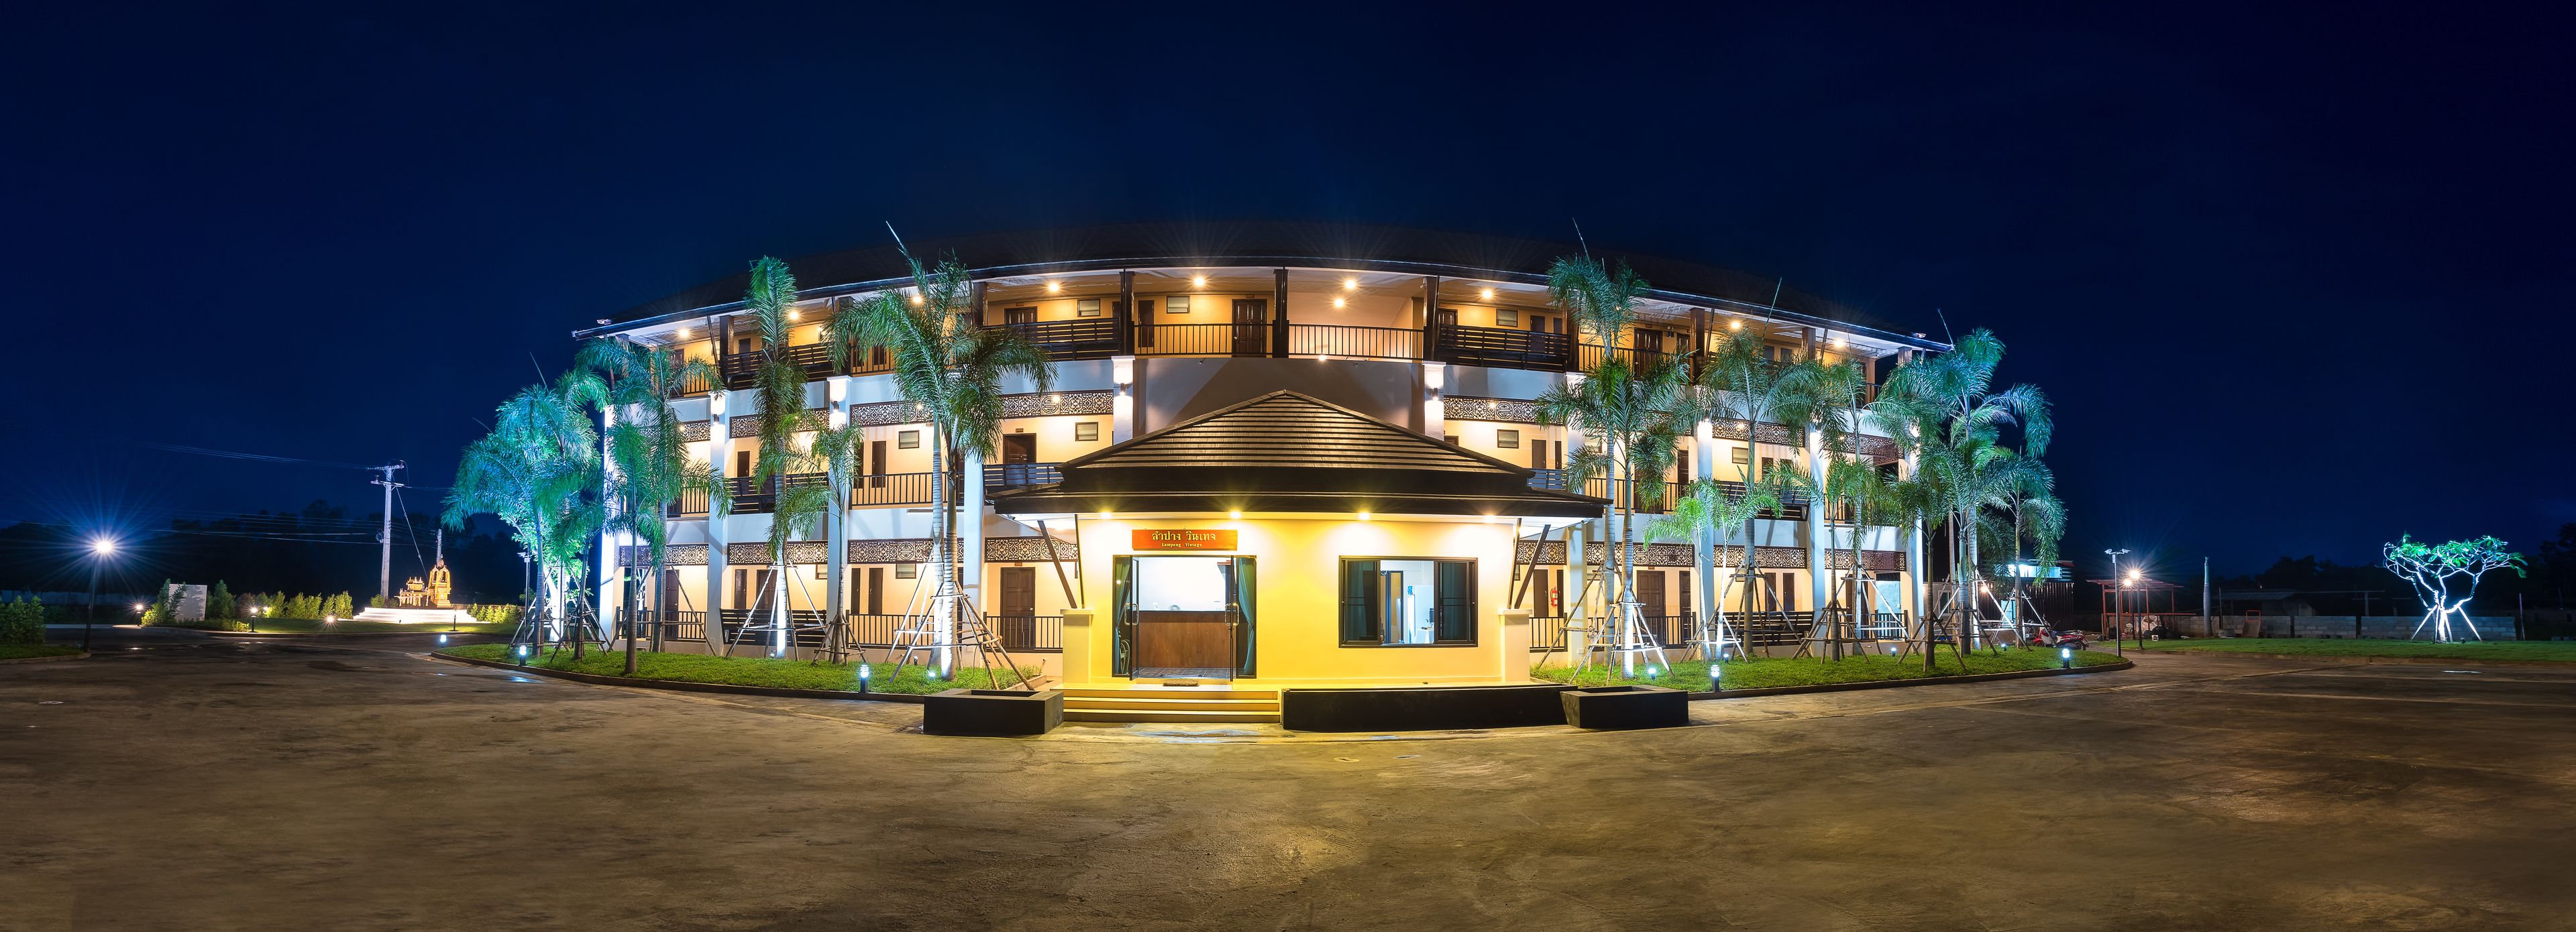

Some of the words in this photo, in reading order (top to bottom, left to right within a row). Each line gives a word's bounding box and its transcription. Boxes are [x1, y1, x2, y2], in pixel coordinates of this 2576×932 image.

[1152, 530, 1181, 540] ลำปาง
[1185, 530, 1216, 540] วินเทจ
